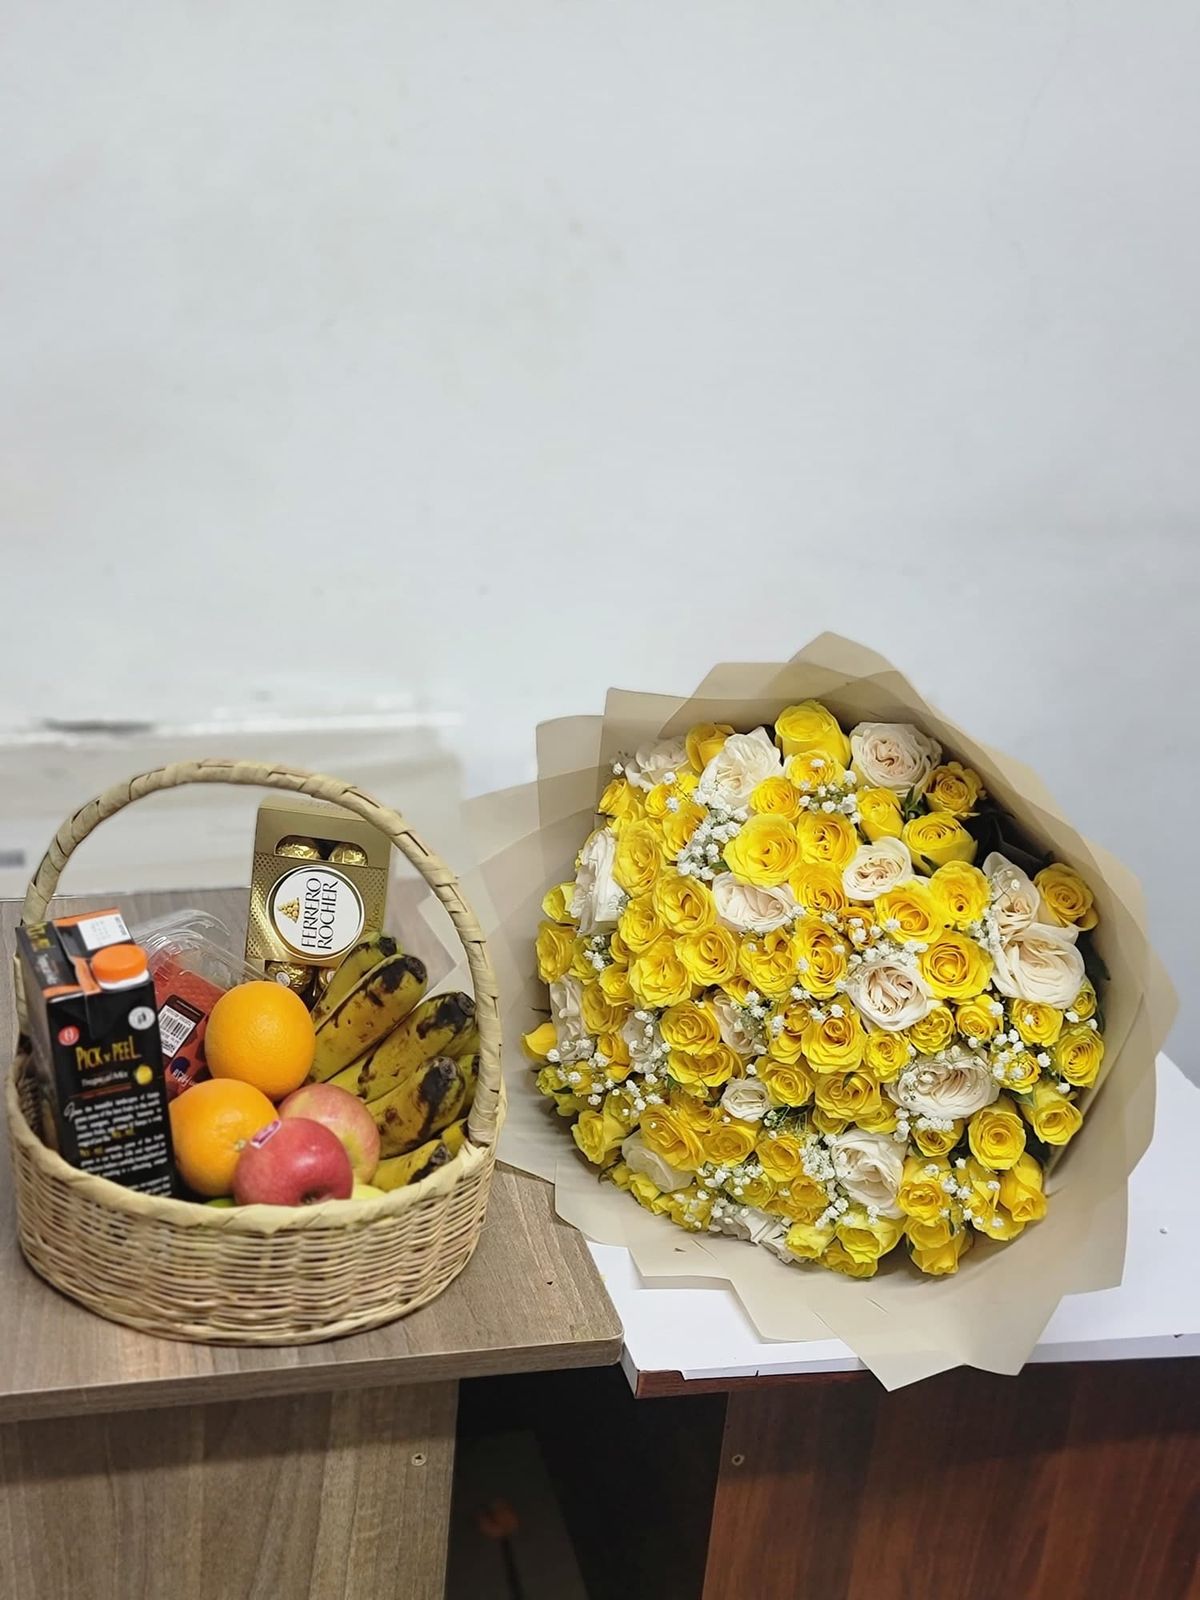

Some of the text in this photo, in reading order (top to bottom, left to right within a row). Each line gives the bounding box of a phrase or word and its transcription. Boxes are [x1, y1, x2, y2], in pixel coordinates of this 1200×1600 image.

[301, 877, 322, 948] FERRERO
[317, 880, 339, 950] ROCHER
[75, 1046, 103, 1071] PICK
[111, 1035, 140, 1061] PEEL
